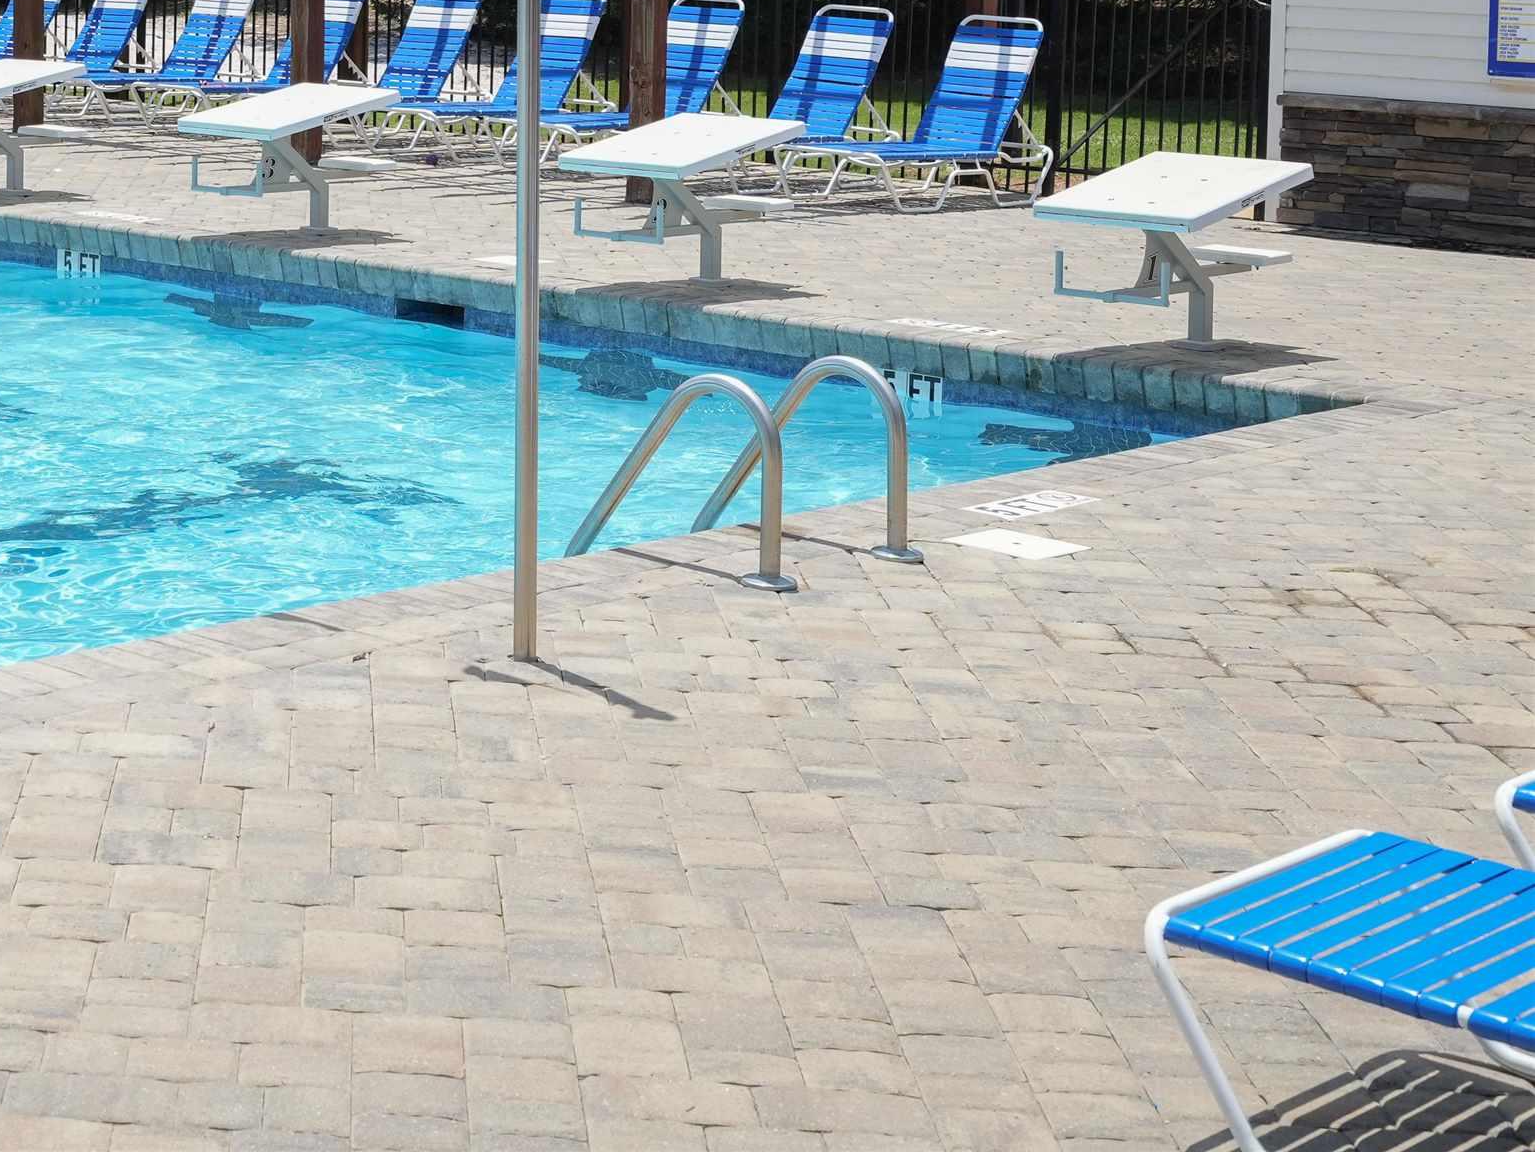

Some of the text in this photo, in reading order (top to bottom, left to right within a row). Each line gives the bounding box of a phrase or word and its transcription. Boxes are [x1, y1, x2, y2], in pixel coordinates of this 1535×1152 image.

[262, 158, 276, 179] 3
[64, 250, 100, 273] 5 FT
[1145, 254, 1157, 282] 1
[908, 373, 941, 402] FT
[997, 497, 1059, 513] FT
